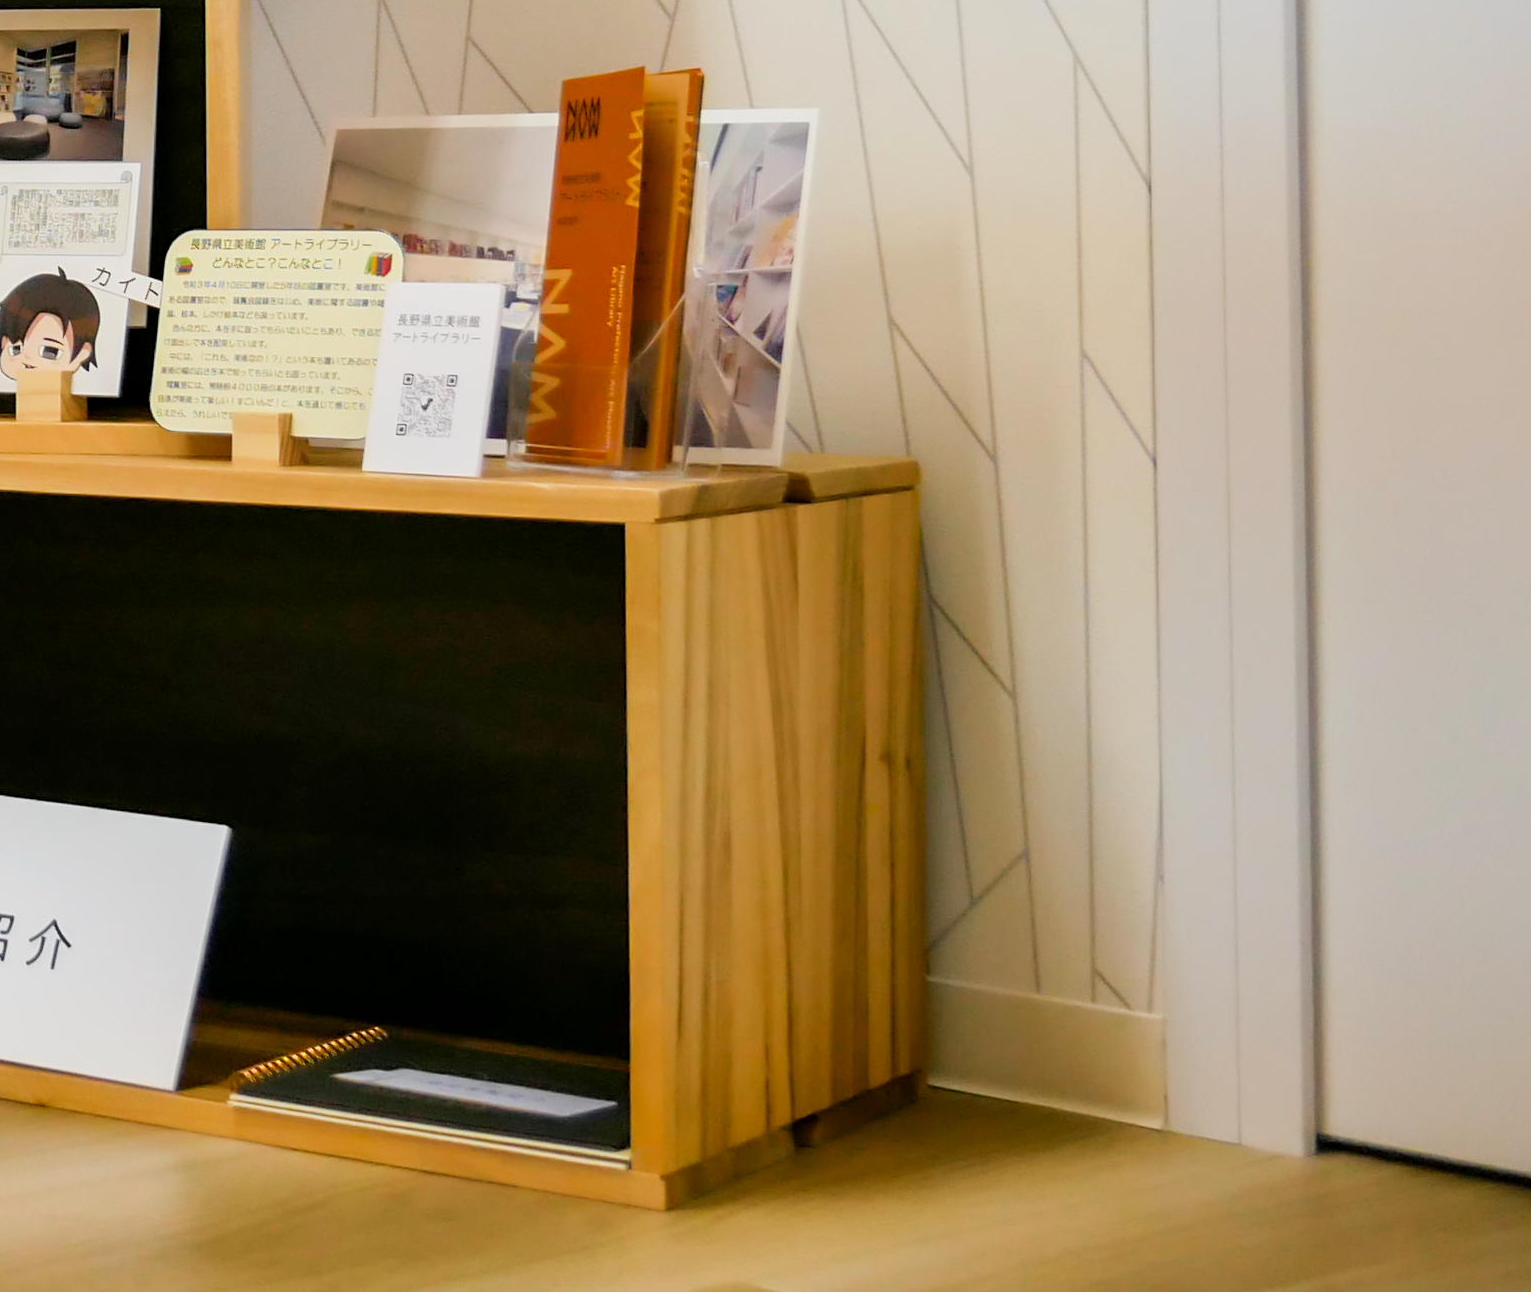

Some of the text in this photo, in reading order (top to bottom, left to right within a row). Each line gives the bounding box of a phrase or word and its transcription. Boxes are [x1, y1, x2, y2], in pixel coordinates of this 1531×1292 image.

[190, 238, 373, 251] 長野県立美術館 アートライブラリー
[211, 257, 343, 270] どんなとこ？こんなとこ！
[91, 267, 160, 299] カイト
[397, 312, 480, 329] 長野県立美術館
[392, 330, 481, 345] アートライブラリー
